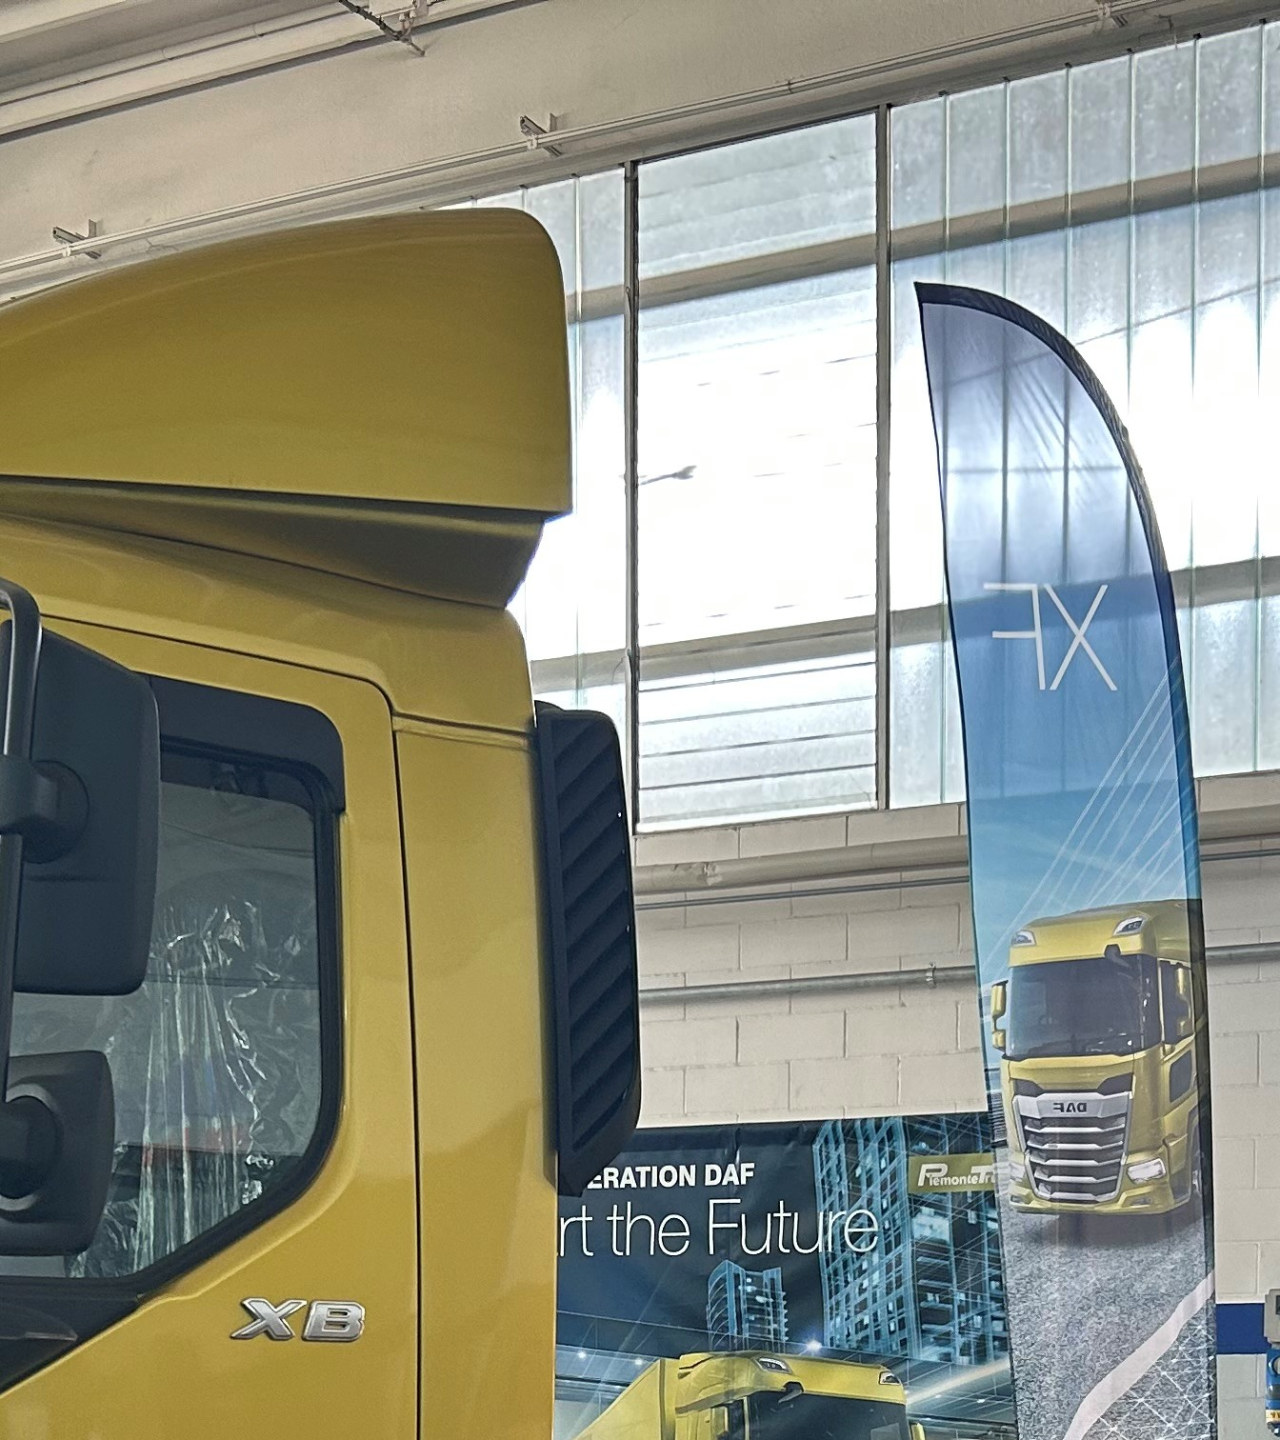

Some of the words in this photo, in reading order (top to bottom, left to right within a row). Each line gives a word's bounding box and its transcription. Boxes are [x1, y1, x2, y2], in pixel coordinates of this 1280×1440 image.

[704, 1162, 755, 1186] DAF
[607, 1203, 691, 1257] the
[707, 1197, 880, 1256] Future
[230, 1297, 366, 1342] XB
